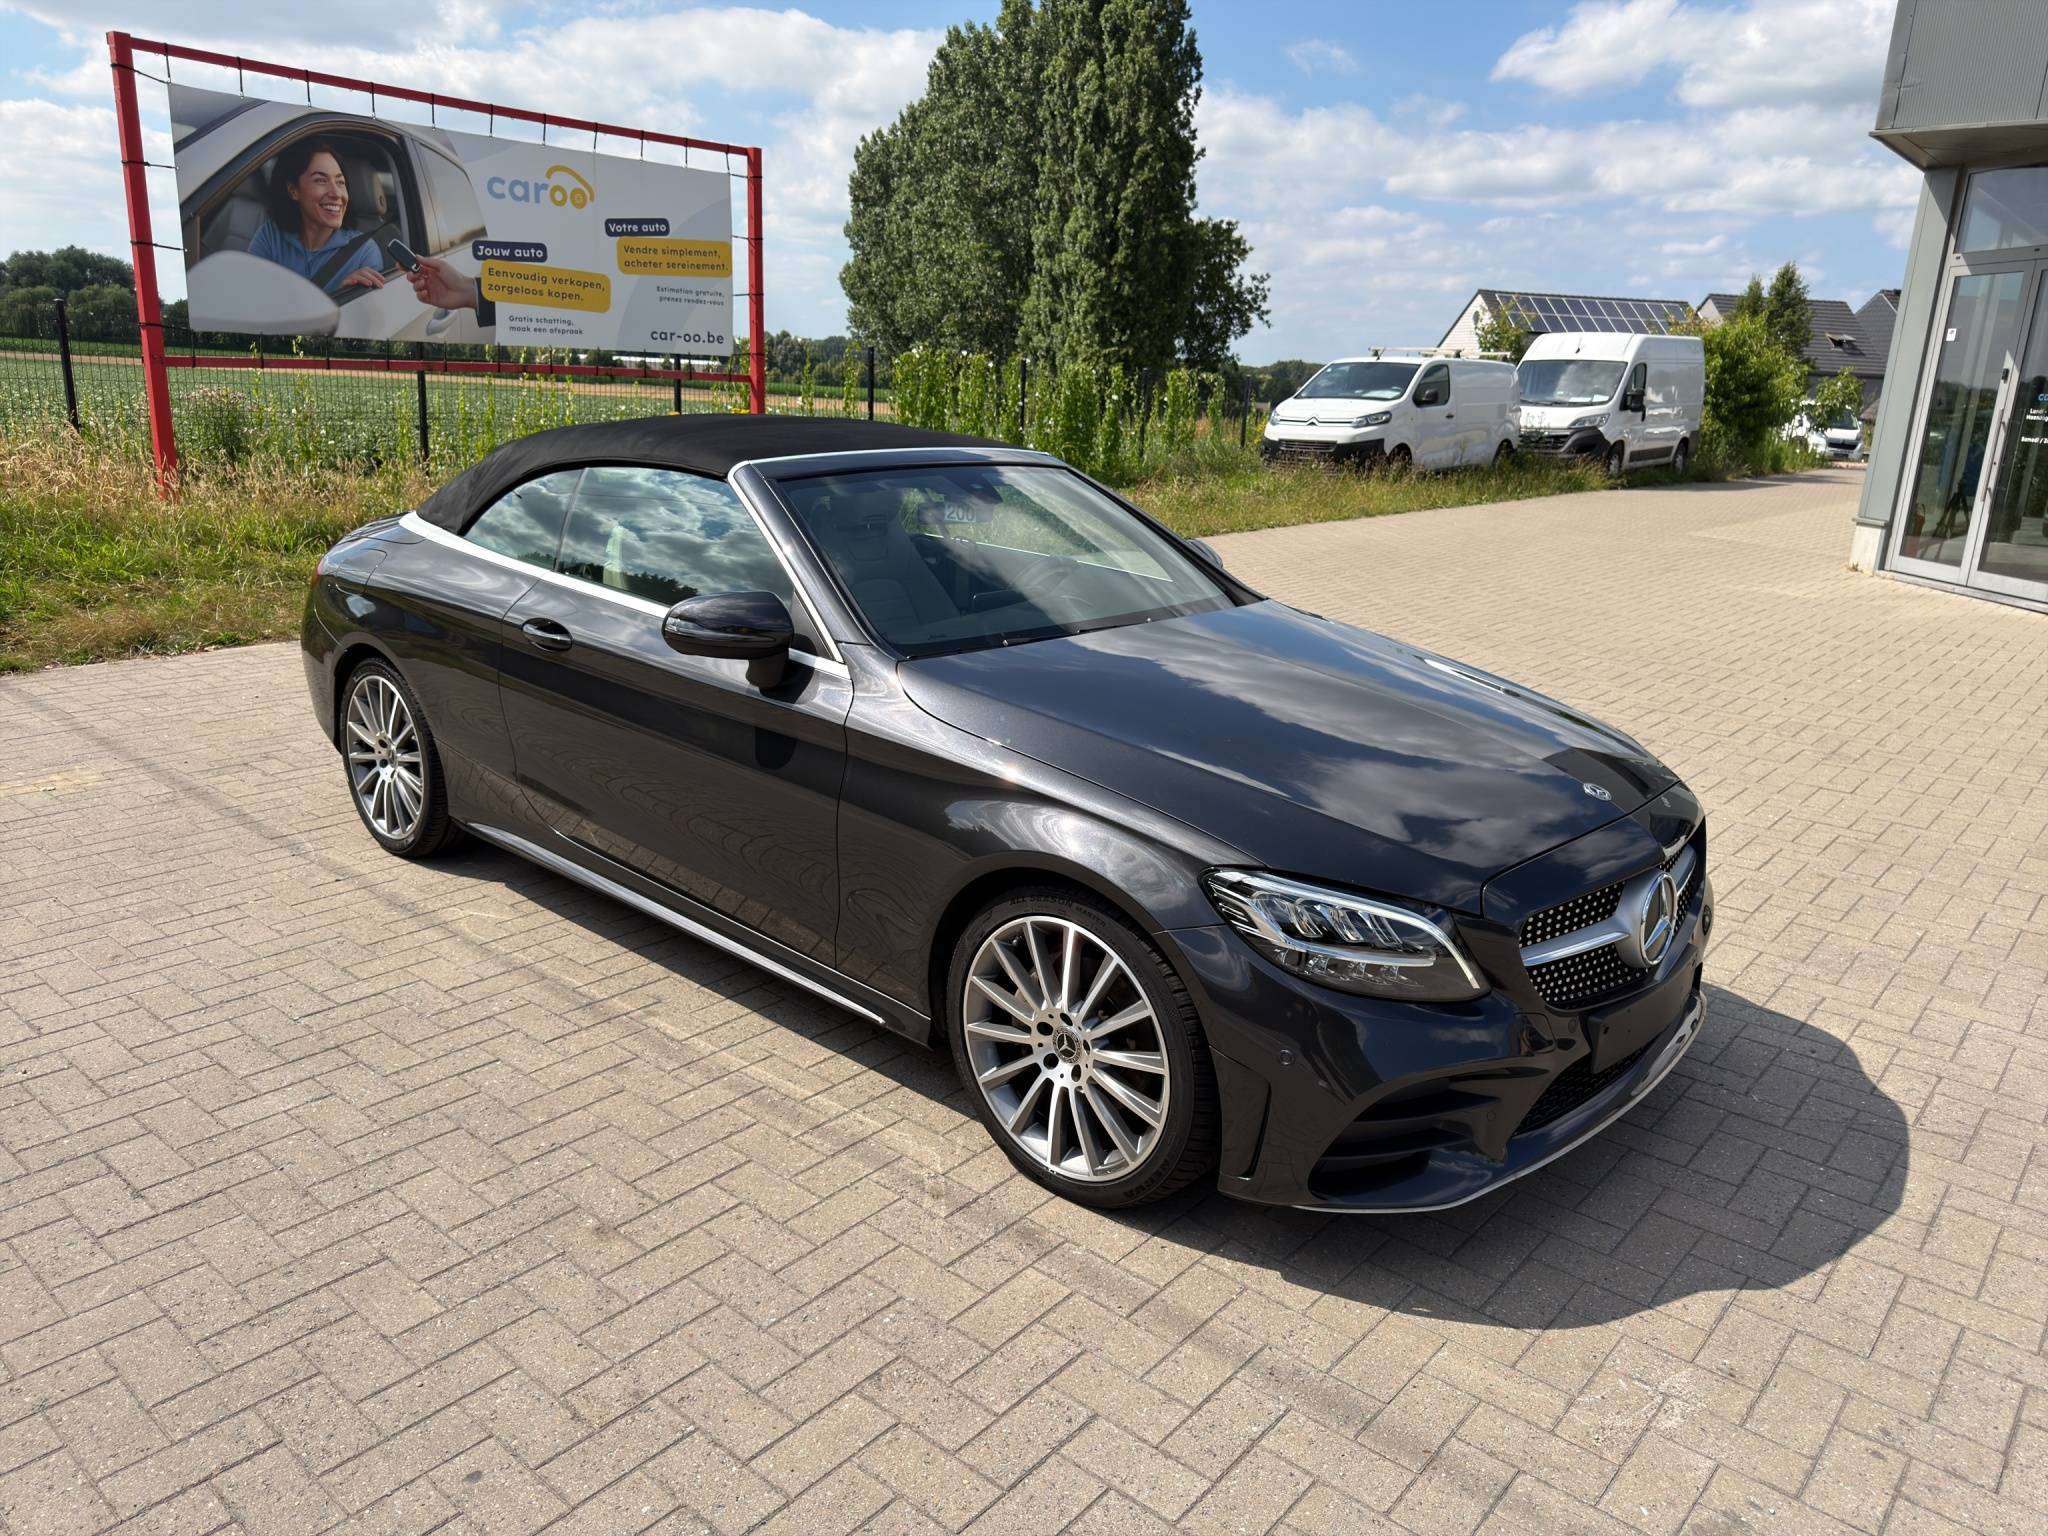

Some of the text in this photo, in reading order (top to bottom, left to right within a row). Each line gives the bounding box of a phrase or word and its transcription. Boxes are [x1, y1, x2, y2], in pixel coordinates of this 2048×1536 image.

[487, 177, 588, 209] caroo
[608, 223, 667, 233] Votre auto
[477, 246, 544, 258] Jouw auto
[623, 246, 721, 259] Vendre simplement,
[624, 259, 729, 271] acheter sereinement.
[488, 267, 605, 292] Eenvoudig verkopen,
[488, 283, 584, 302] zorgeloos kopen.
[656, 286, 693, 295] Estimation
[508, 315, 574, 326] Gratis schatting,
[650, 330, 725, 344] car-oo.be
